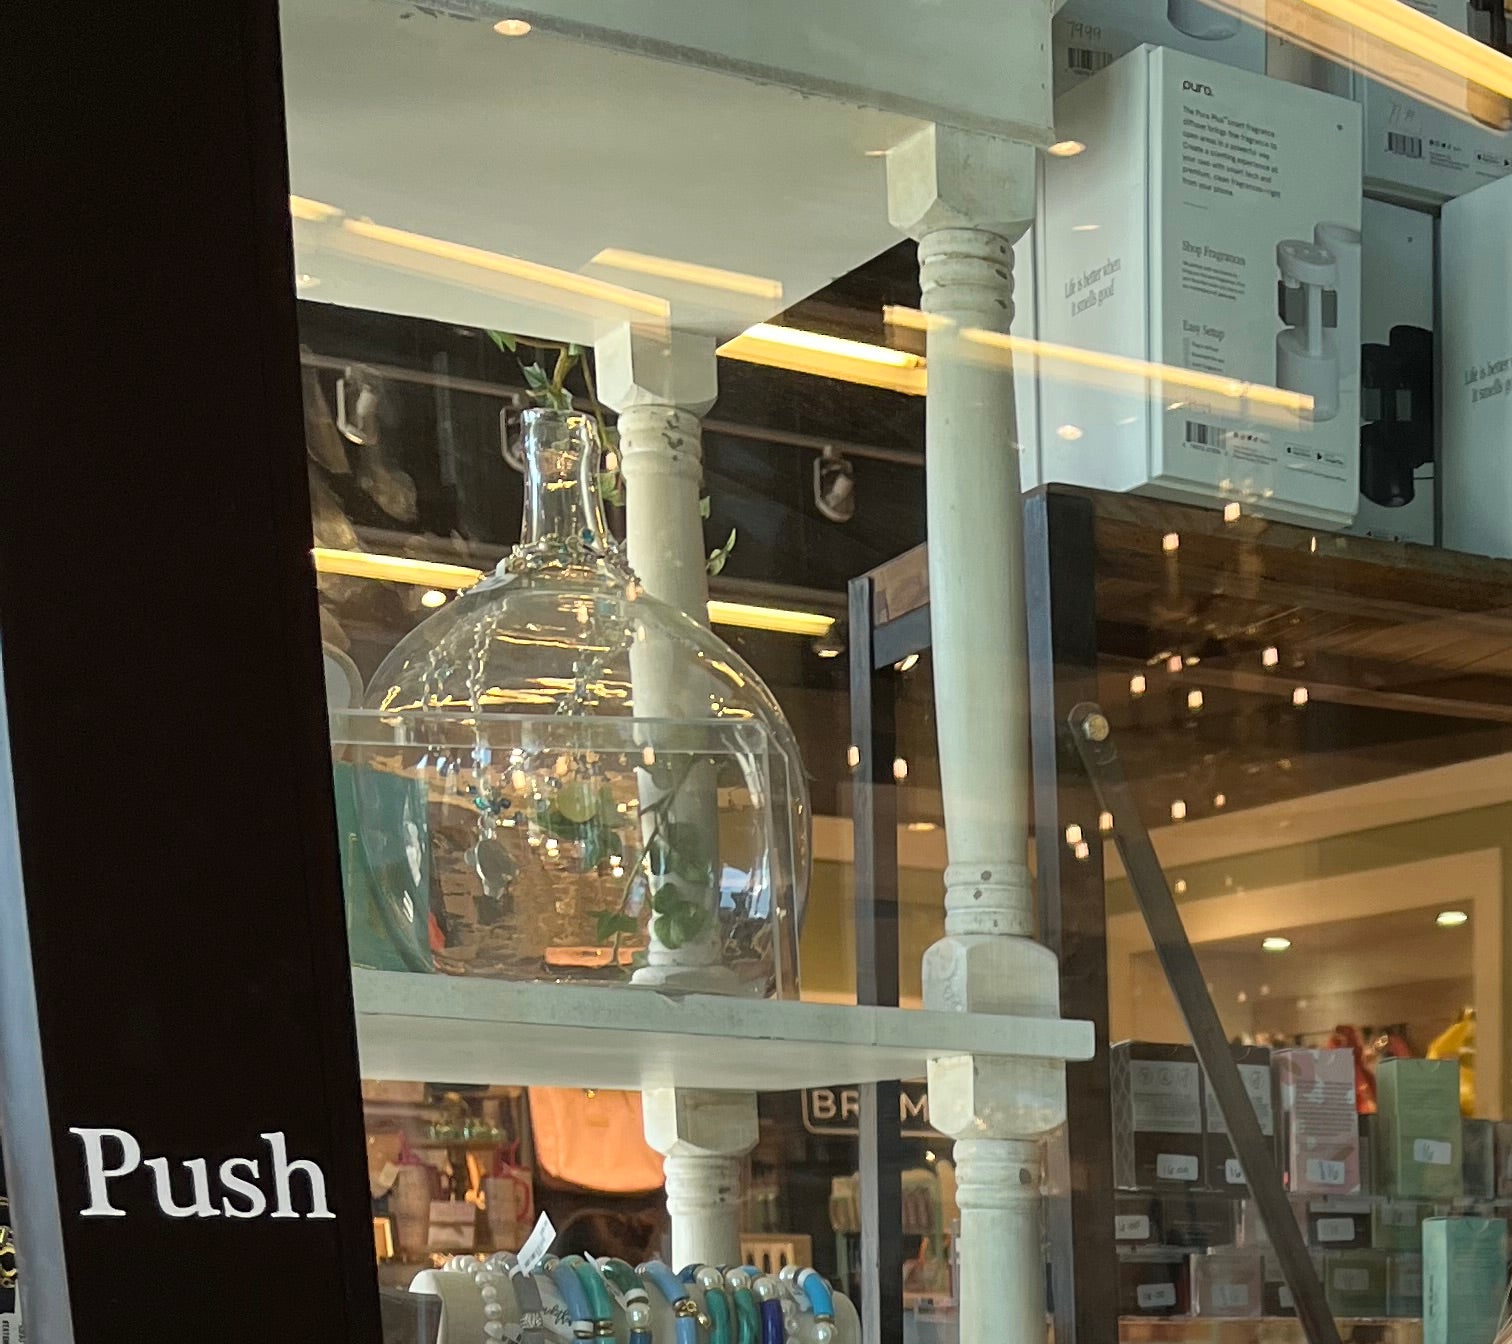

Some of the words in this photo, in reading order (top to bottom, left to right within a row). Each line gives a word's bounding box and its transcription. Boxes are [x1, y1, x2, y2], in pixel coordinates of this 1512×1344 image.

[1246, 123, 1276, 138] fragrance
[1182, 240, 1203, 257] Shop
[1064, 278, 1076, 299] Life
[1083, 268, 1101, 288] better
[1103, 257, 1121, 276] when
[1077, 289, 1097, 314] smells
[1097, 278, 1115, 306] good
[1463, 366, 1478, 386] Life
[1486, 359, 1509, 377] better
[1479, 377, 1503, 399] smells
[69, 1126, 336, 1220] Push
